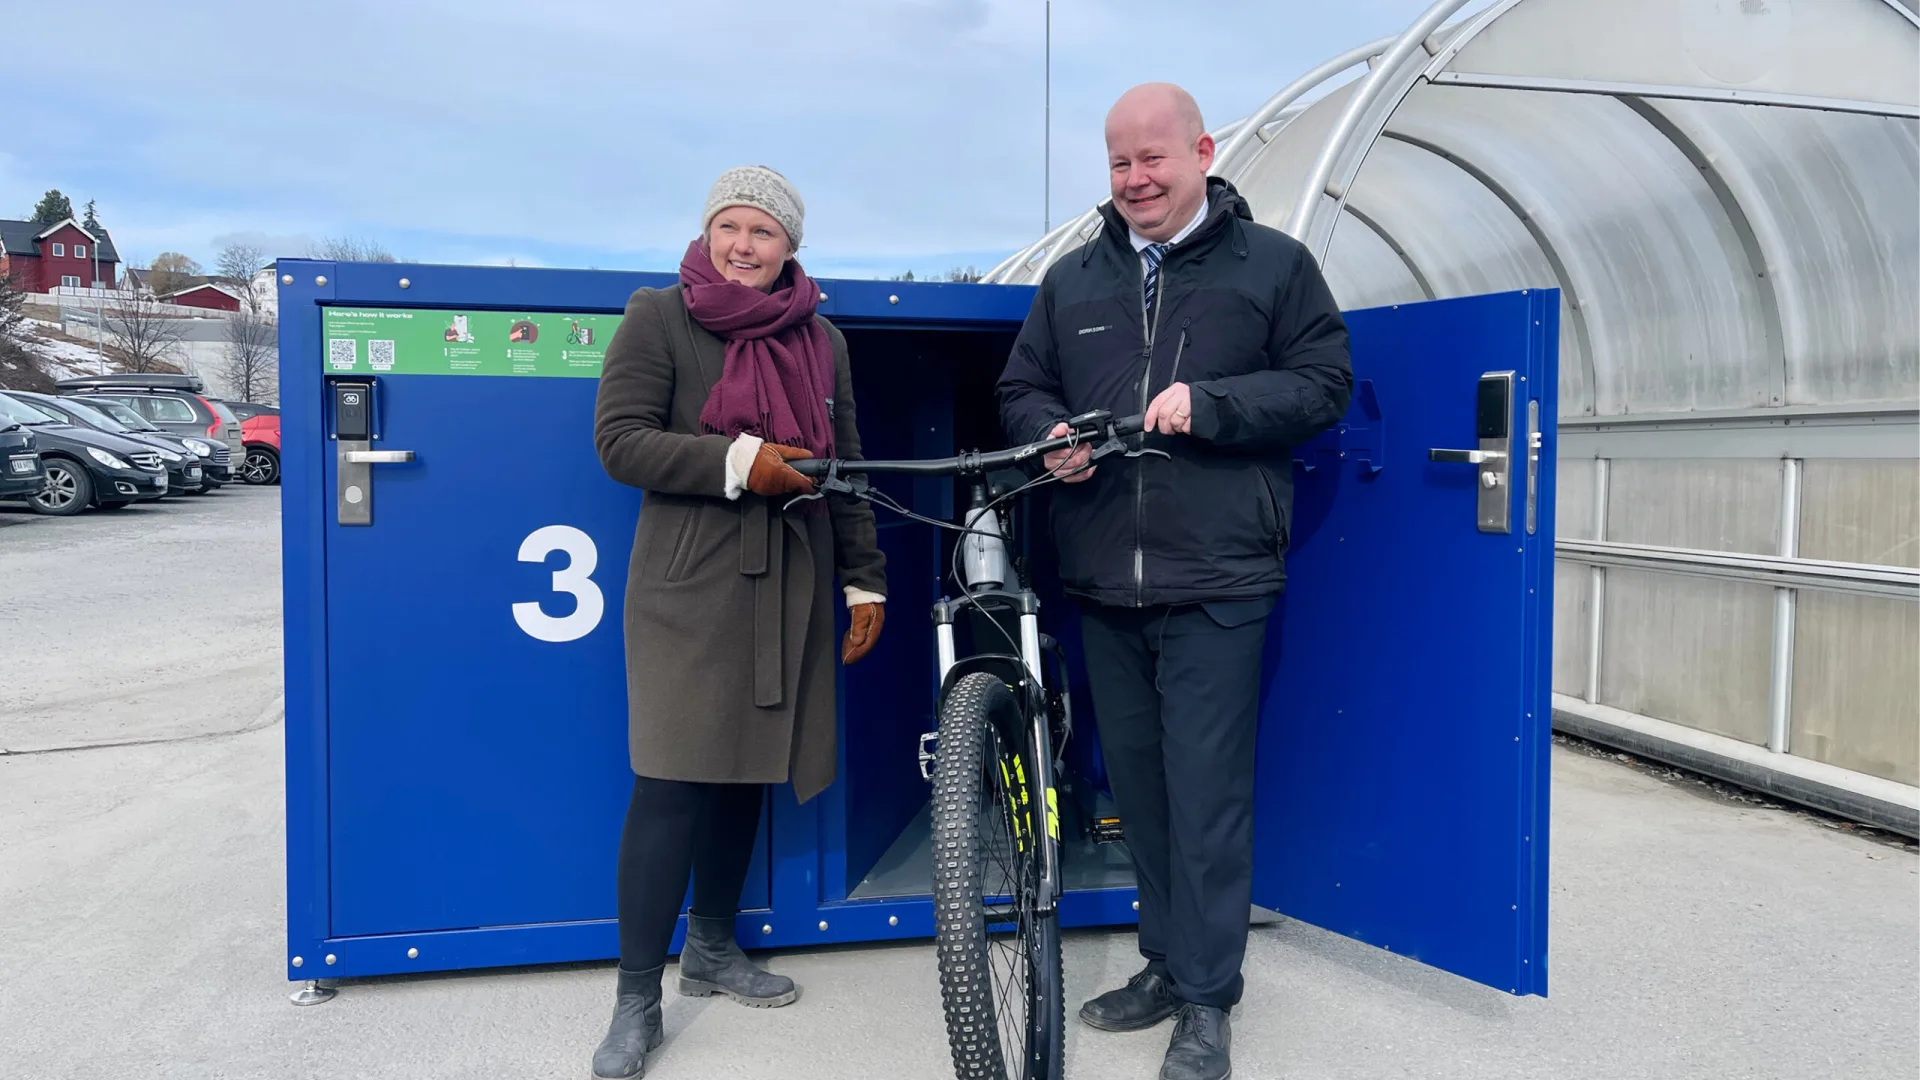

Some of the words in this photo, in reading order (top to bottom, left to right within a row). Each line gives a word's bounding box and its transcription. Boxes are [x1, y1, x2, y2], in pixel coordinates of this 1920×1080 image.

[328, 310, 358, 318] Here's
[378, 311, 385, 319] it
[444, 347, 448, 356] 1
[506, 349, 512, 358] 2
[562, 350, 567, 360] 3
[512, 524, 604, 643] 3
